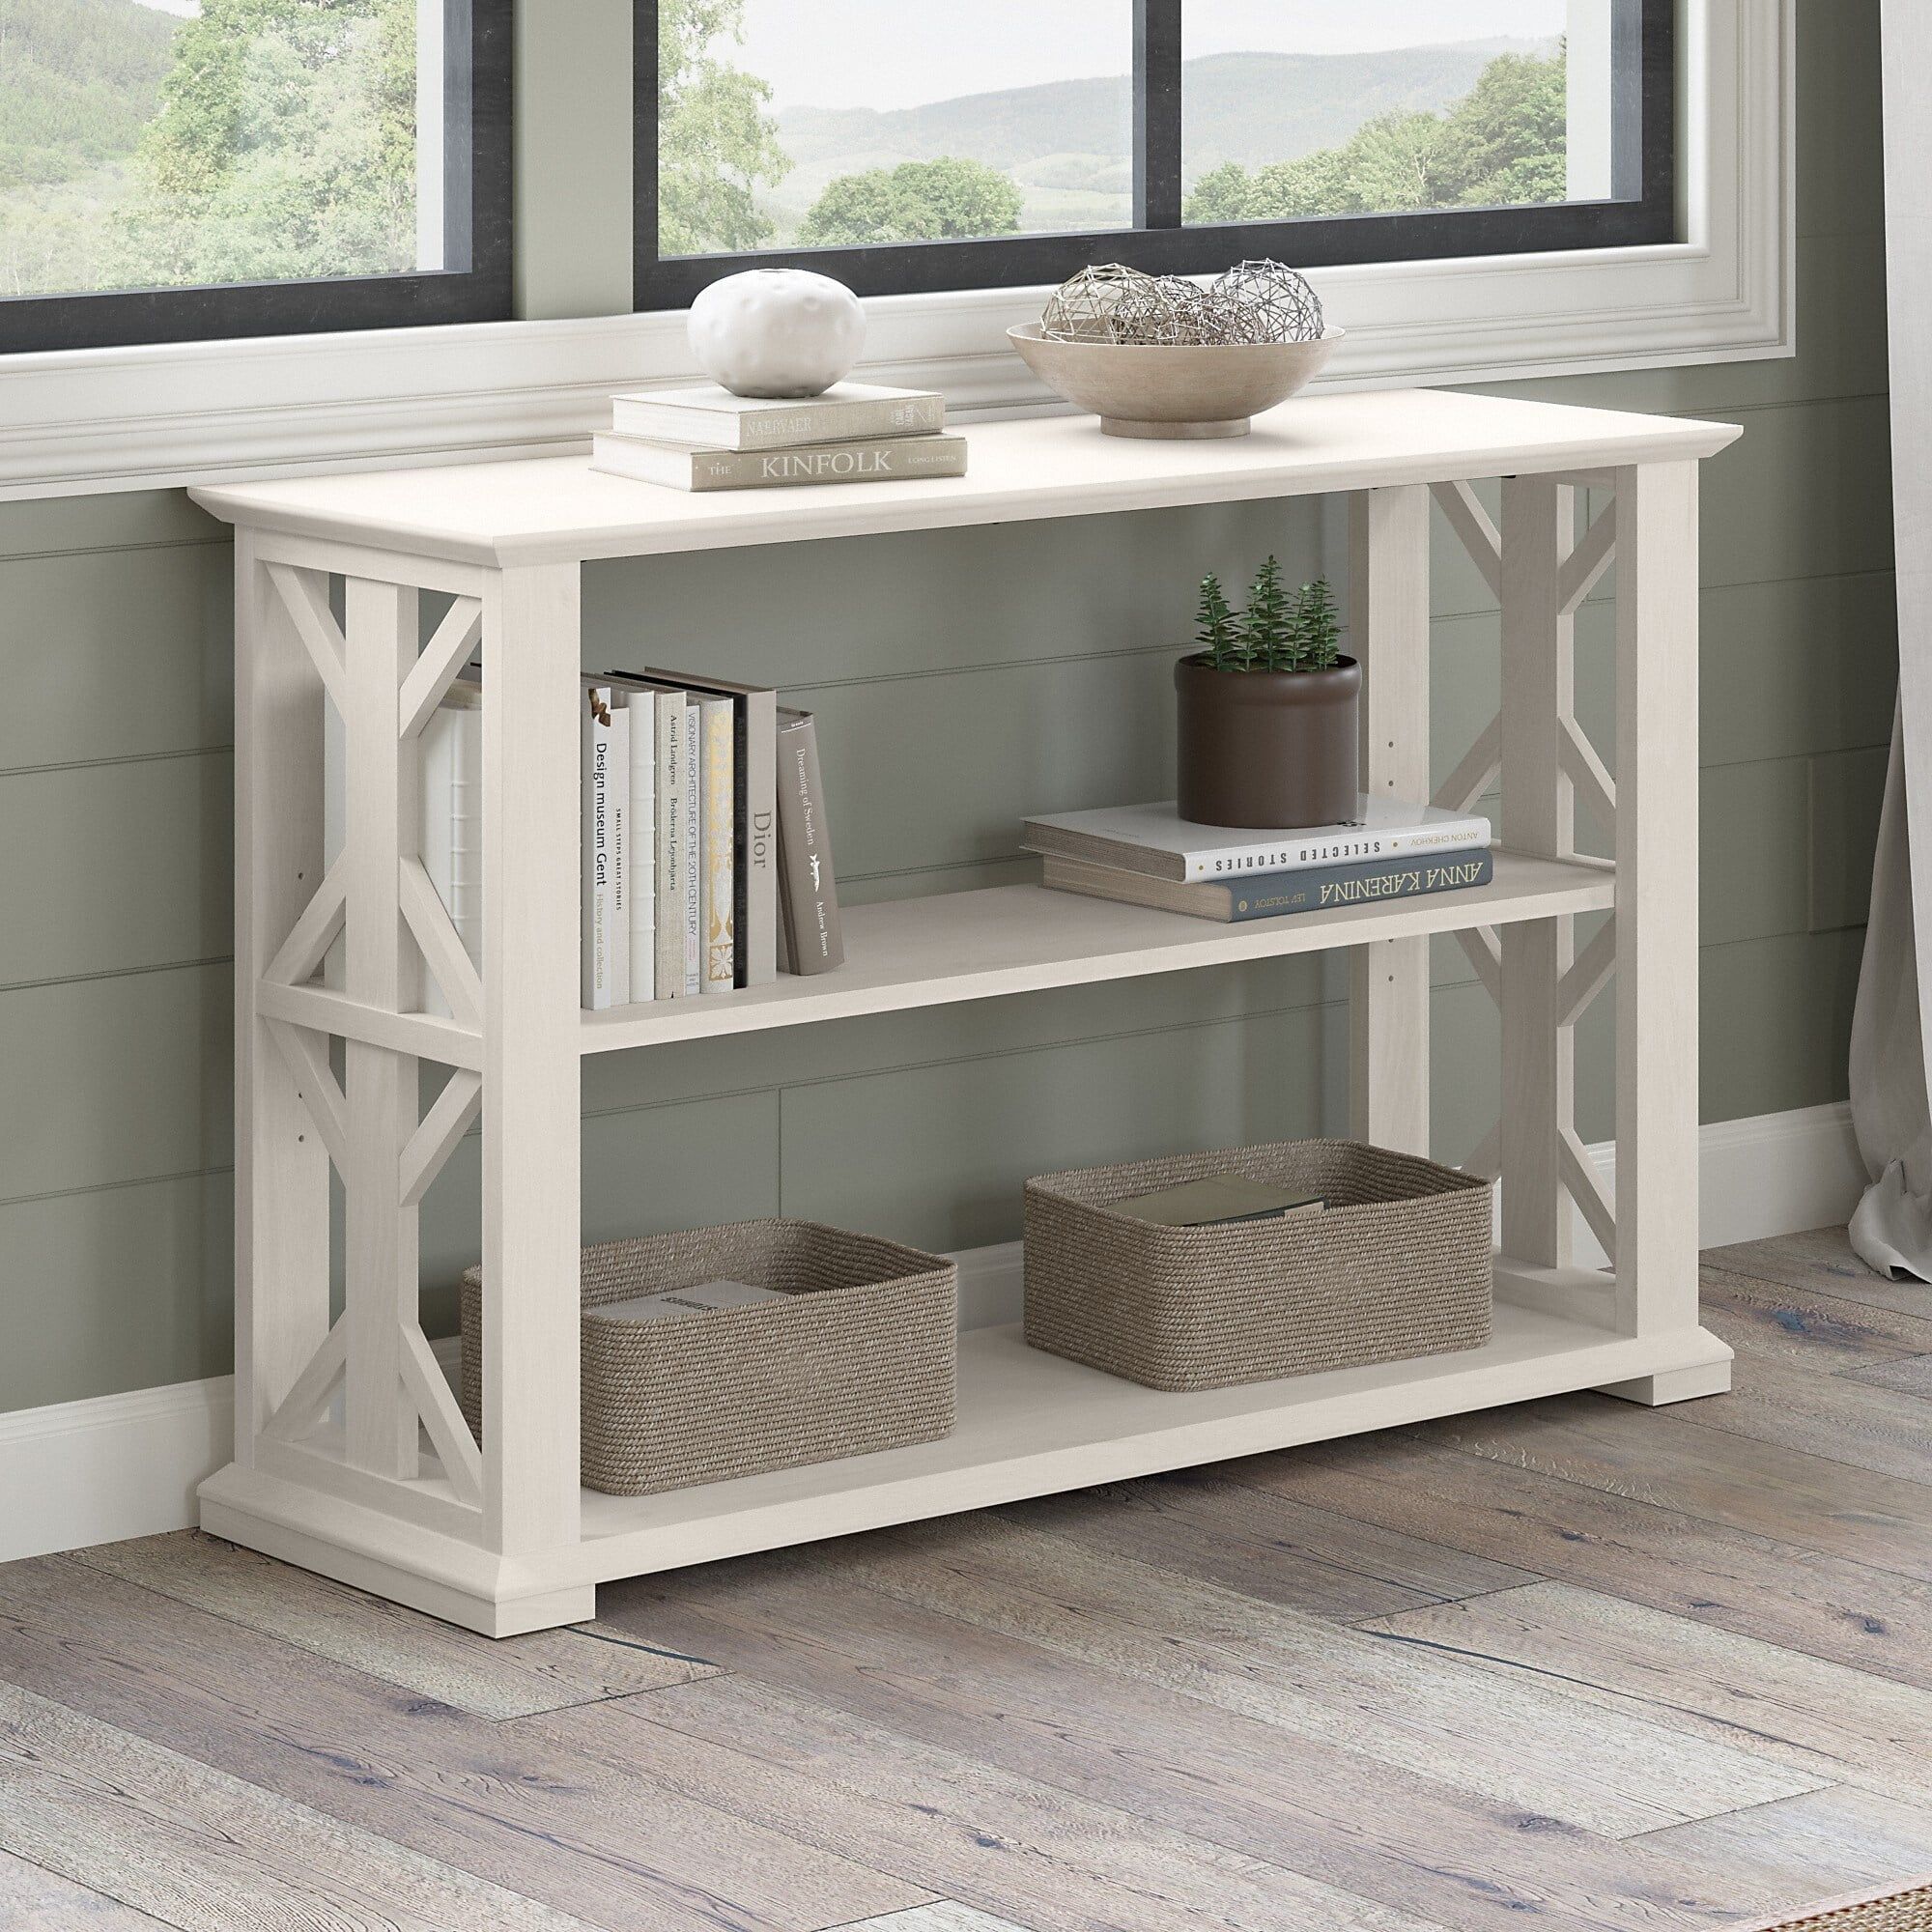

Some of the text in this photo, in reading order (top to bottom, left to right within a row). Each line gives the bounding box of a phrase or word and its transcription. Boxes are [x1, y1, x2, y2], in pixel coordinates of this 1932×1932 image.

[708, 465, 733, 475] THE
[760, 451, 893, 478] KINFOLK
[796, 748, 808, 796] Dreaming
[688, 757, 696, 825] ARCHITECTURE
[803, 797, 810, 807] of
[688, 826, 696, 839] OF
[753, 810, 772, 868] Dior
[804, 808, 814, 845] Sweden
[688, 841, 696, 859] THE
[1215, 833, 1478, 871] ANTON CHEKHOV SELECTED STORIES
[593, 743, 607, 989] Design museum Gent History and collection
[688, 861, 696, 888] 20TH
[1426, 862, 1484, 889] ANNA
[1255, 895, 1290, 909] TOLSTOY
[1320, 871, 1421, 904] KARENINA
[688, 889, 696, 936] CENTURY
[819, 931, 828, 957] Brown
